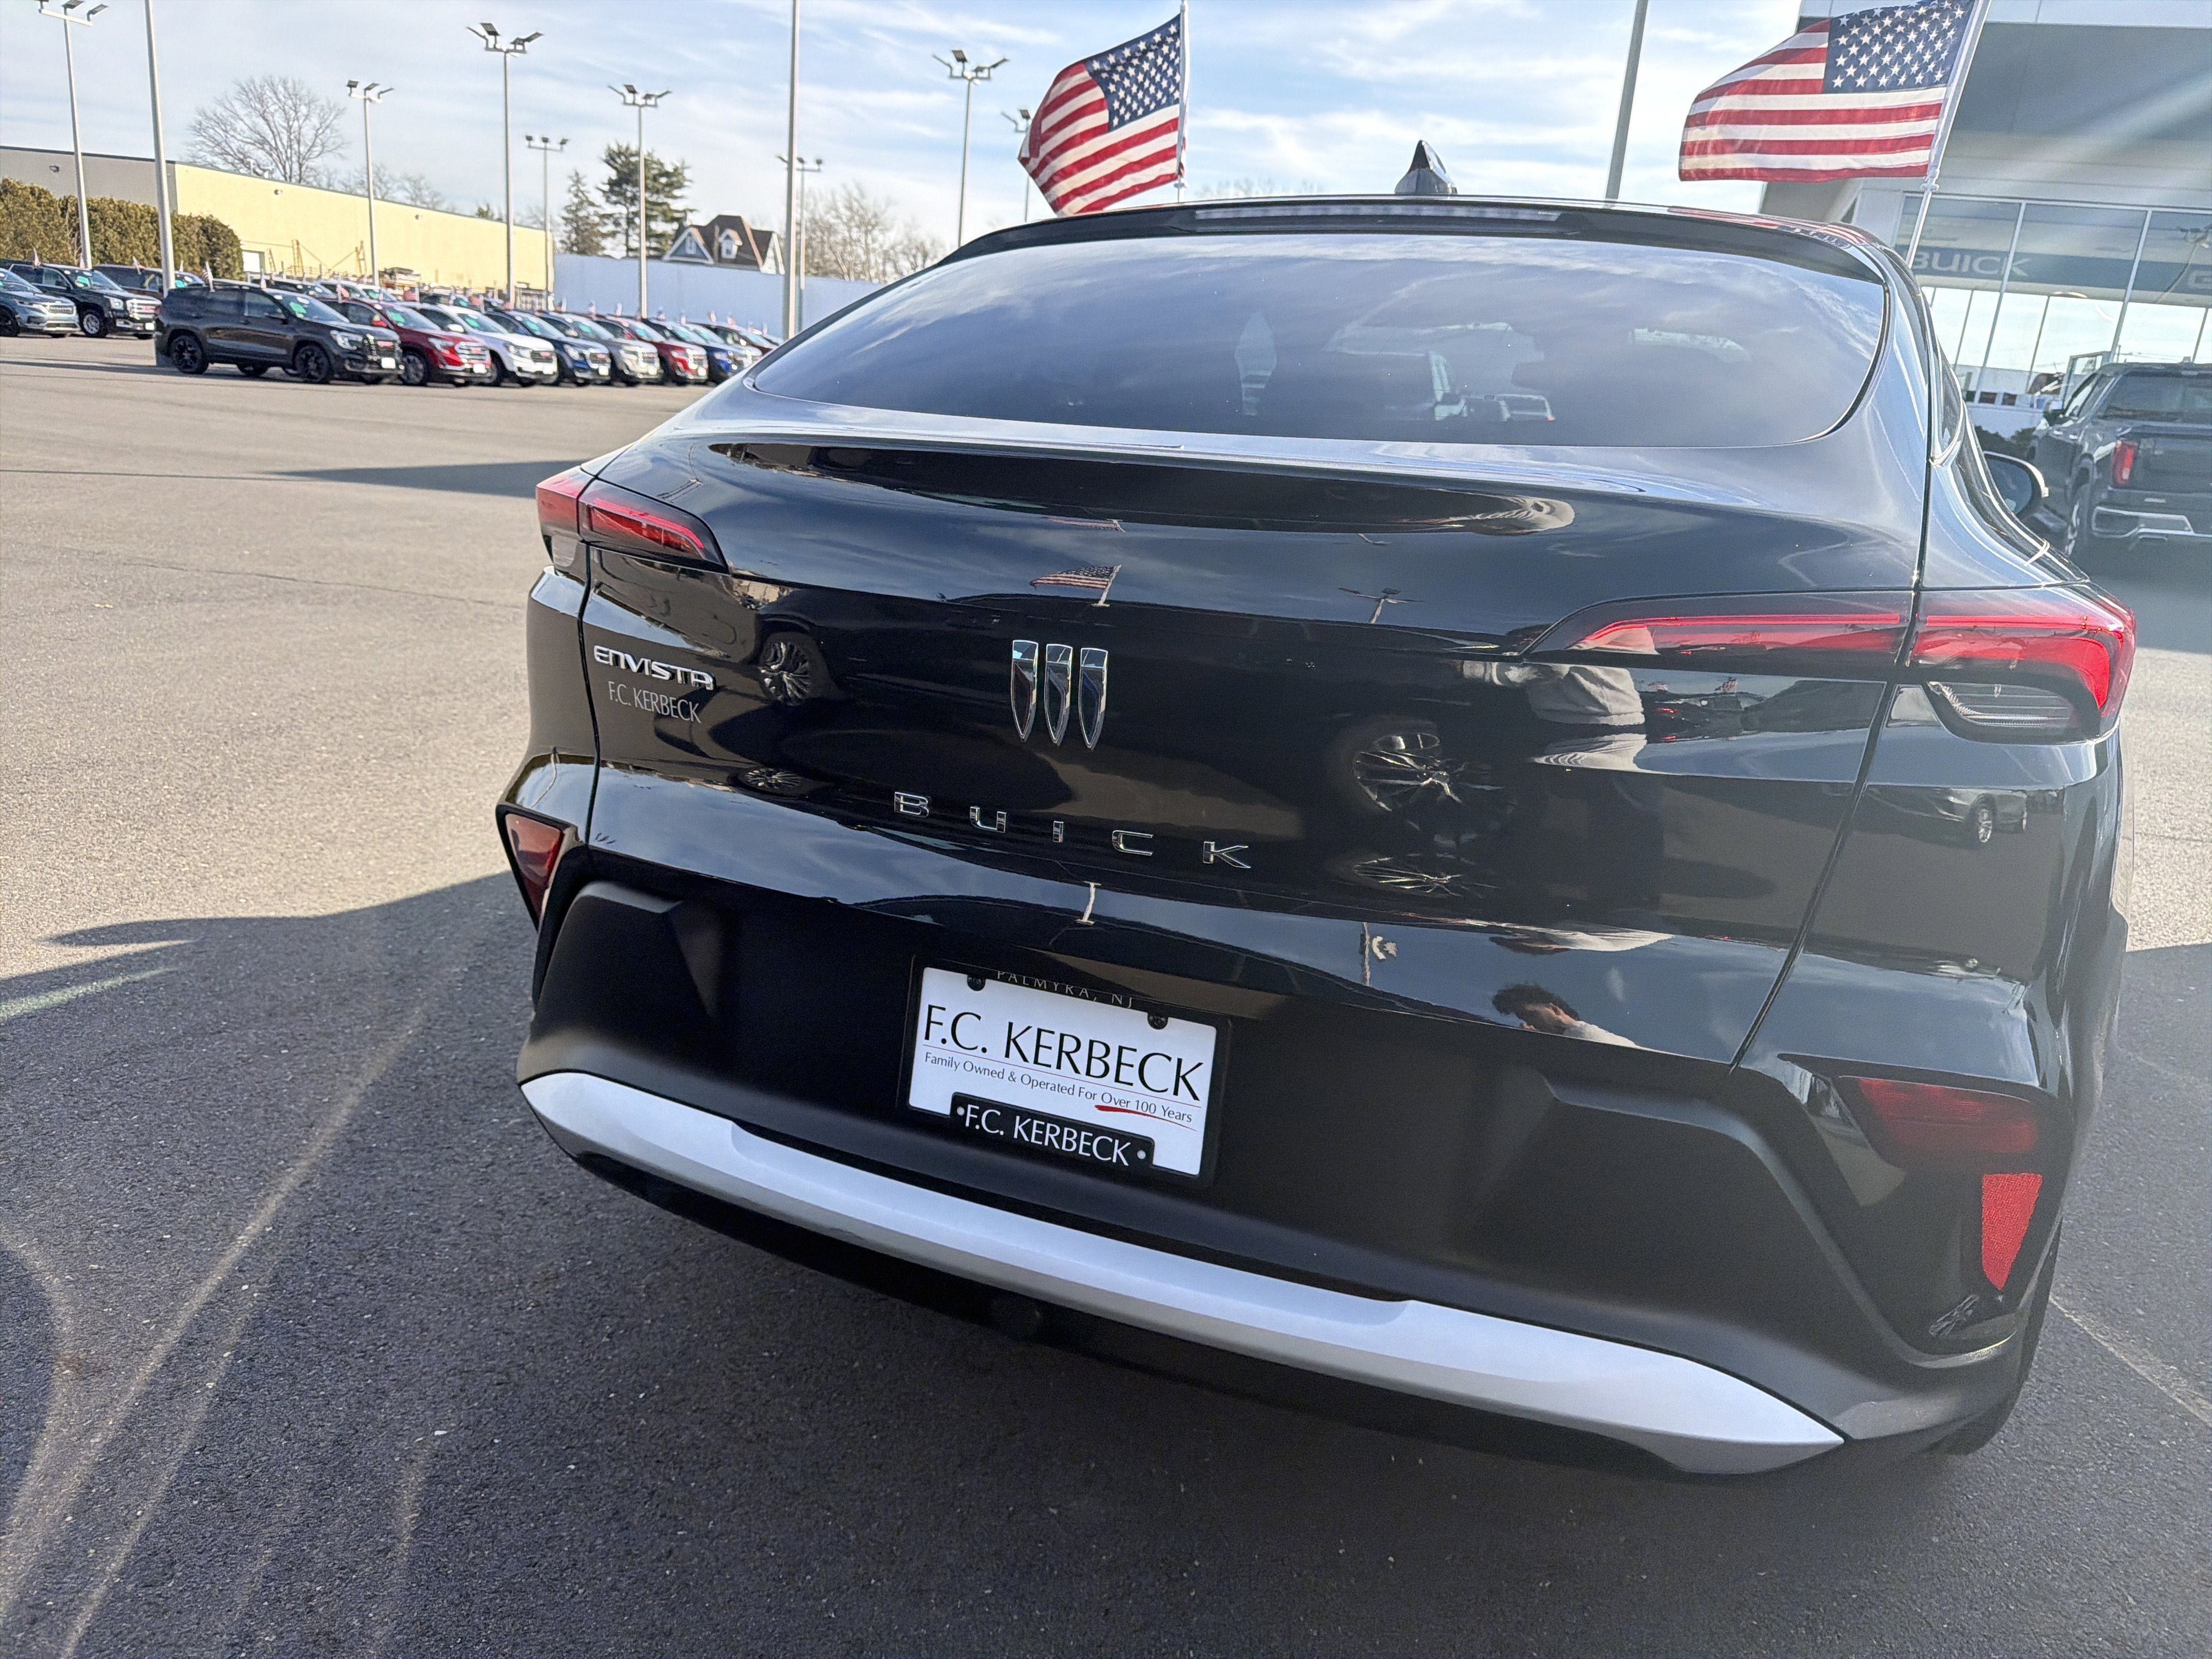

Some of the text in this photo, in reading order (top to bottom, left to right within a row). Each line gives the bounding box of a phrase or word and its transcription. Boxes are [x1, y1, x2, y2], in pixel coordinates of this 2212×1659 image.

[1912, 252, 2030, 277] BUICK
[594, 645, 715, 691] ENVISTA
[607, 681, 702, 724] F.C. KERBECK
[894, 792, 1251, 868] BUICK
[1111, 994, 1132, 1008] NJ
[923, 1005, 1204, 1101] F.C. KERBECK
[925, 1052, 1193, 1122] Family Owned & Operated For Over 100 Years
[966, 1104, 1131, 1166] F.C. KERBECK
